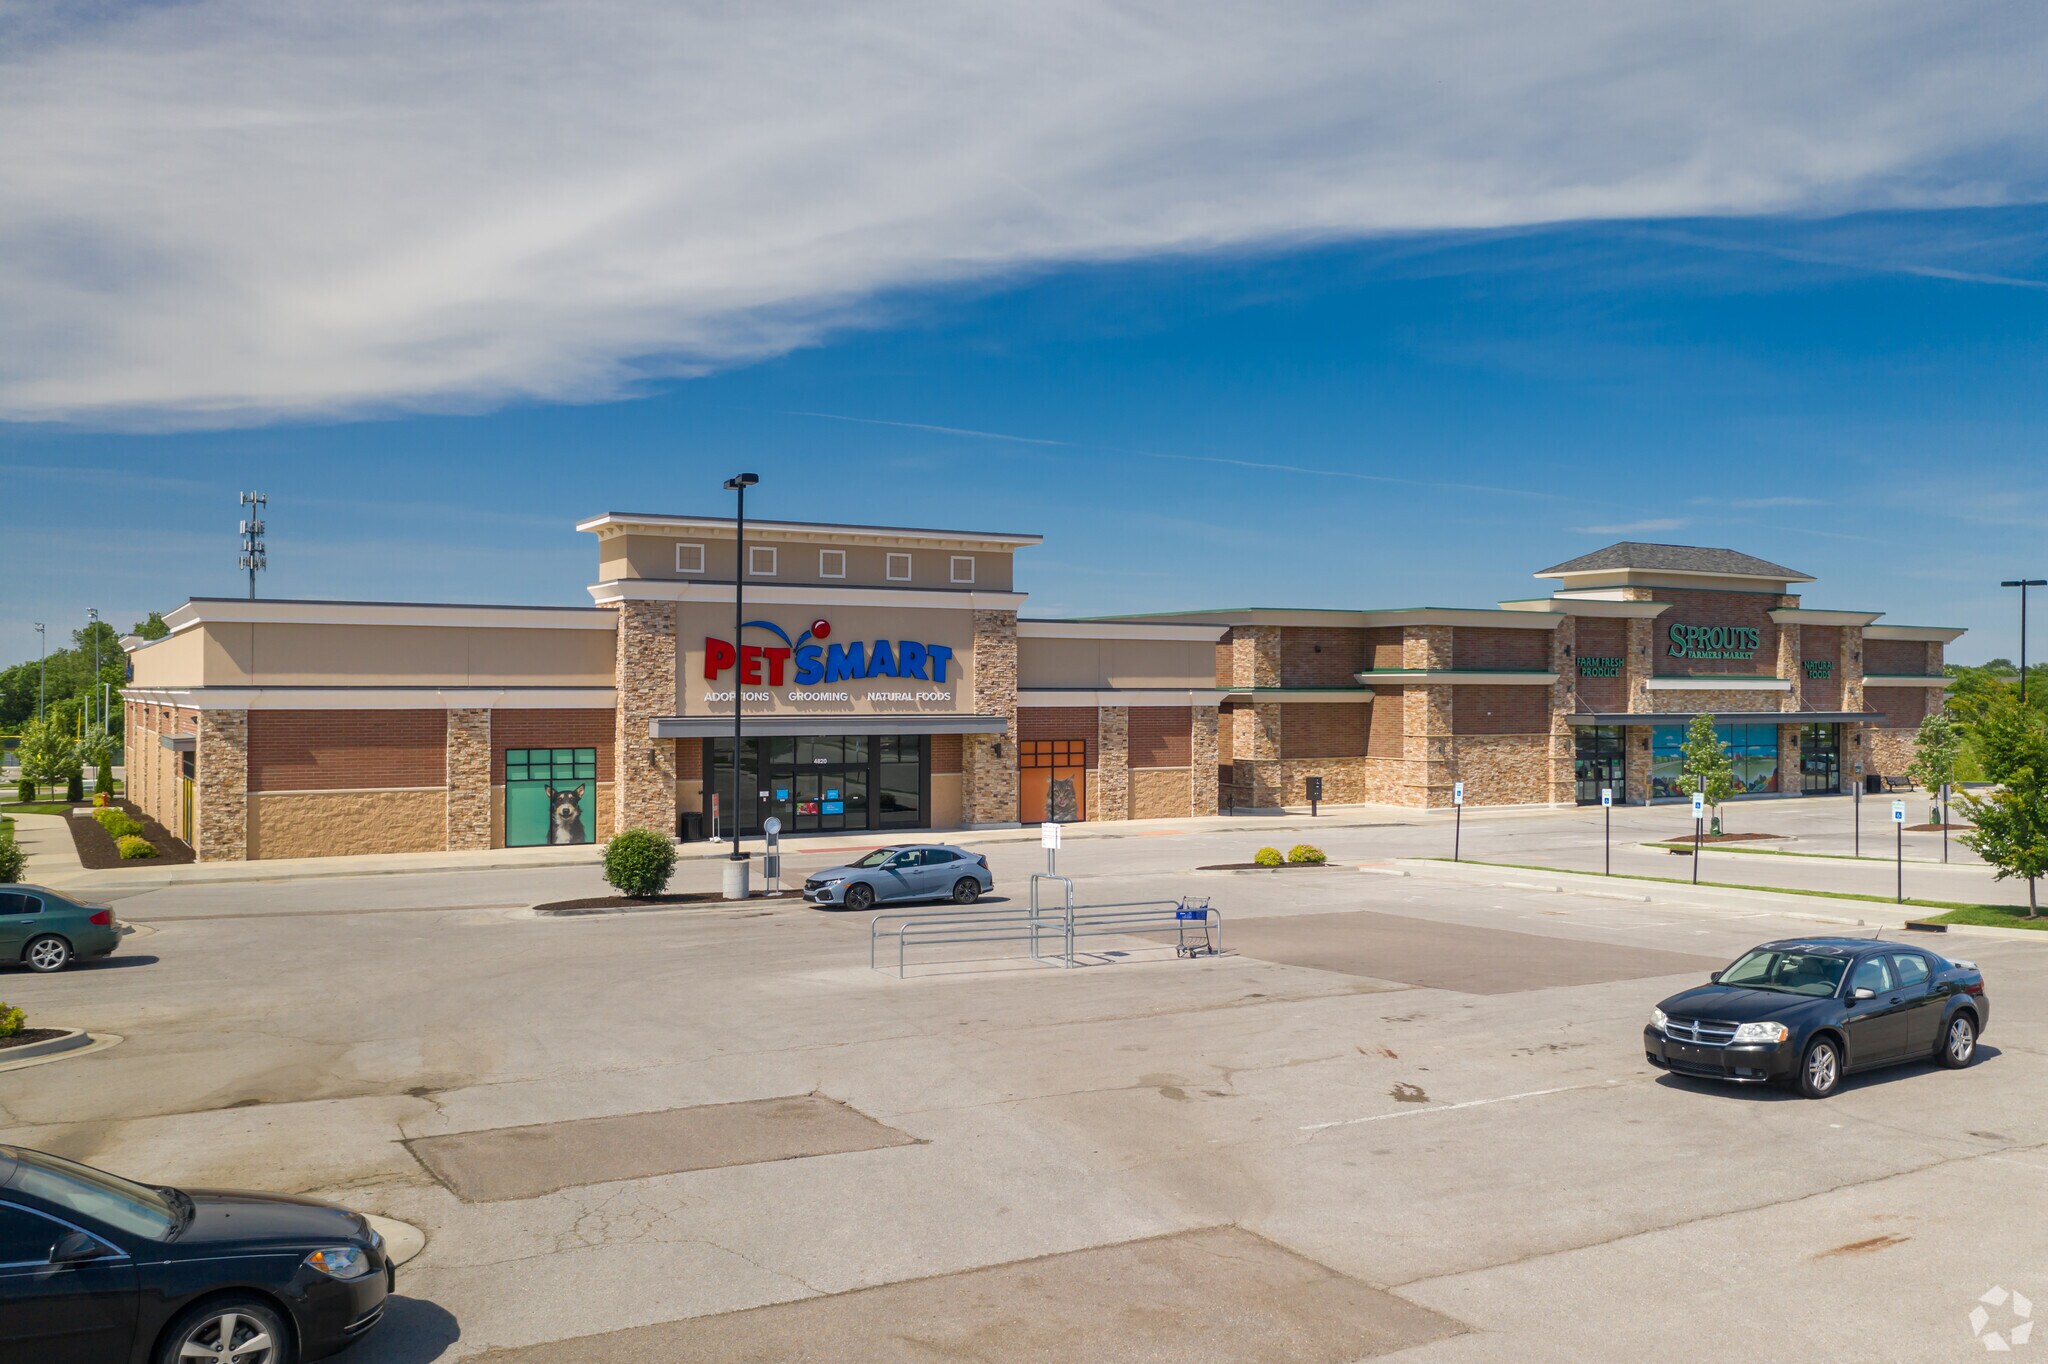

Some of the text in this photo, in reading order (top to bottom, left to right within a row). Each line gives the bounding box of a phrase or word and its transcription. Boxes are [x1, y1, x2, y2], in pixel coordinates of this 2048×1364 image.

[1667, 623, 1760, 657] SPROUTS
[1687, 651, 1754, 660] FARMERS MARKET
[1576, 657, 1625, 667] FARM FRESH
[1804, 661, 1834, 670] NATURAL
[1581, 667, 1620, 677] PRODUCE
[1809, 670, 1831, 679] FOODS
[703, 692, 770, 701] ADOPIONS
[788, 692, 849, 702] GROOMING
[867, 692, 952, 701] NATURAL FOODS
